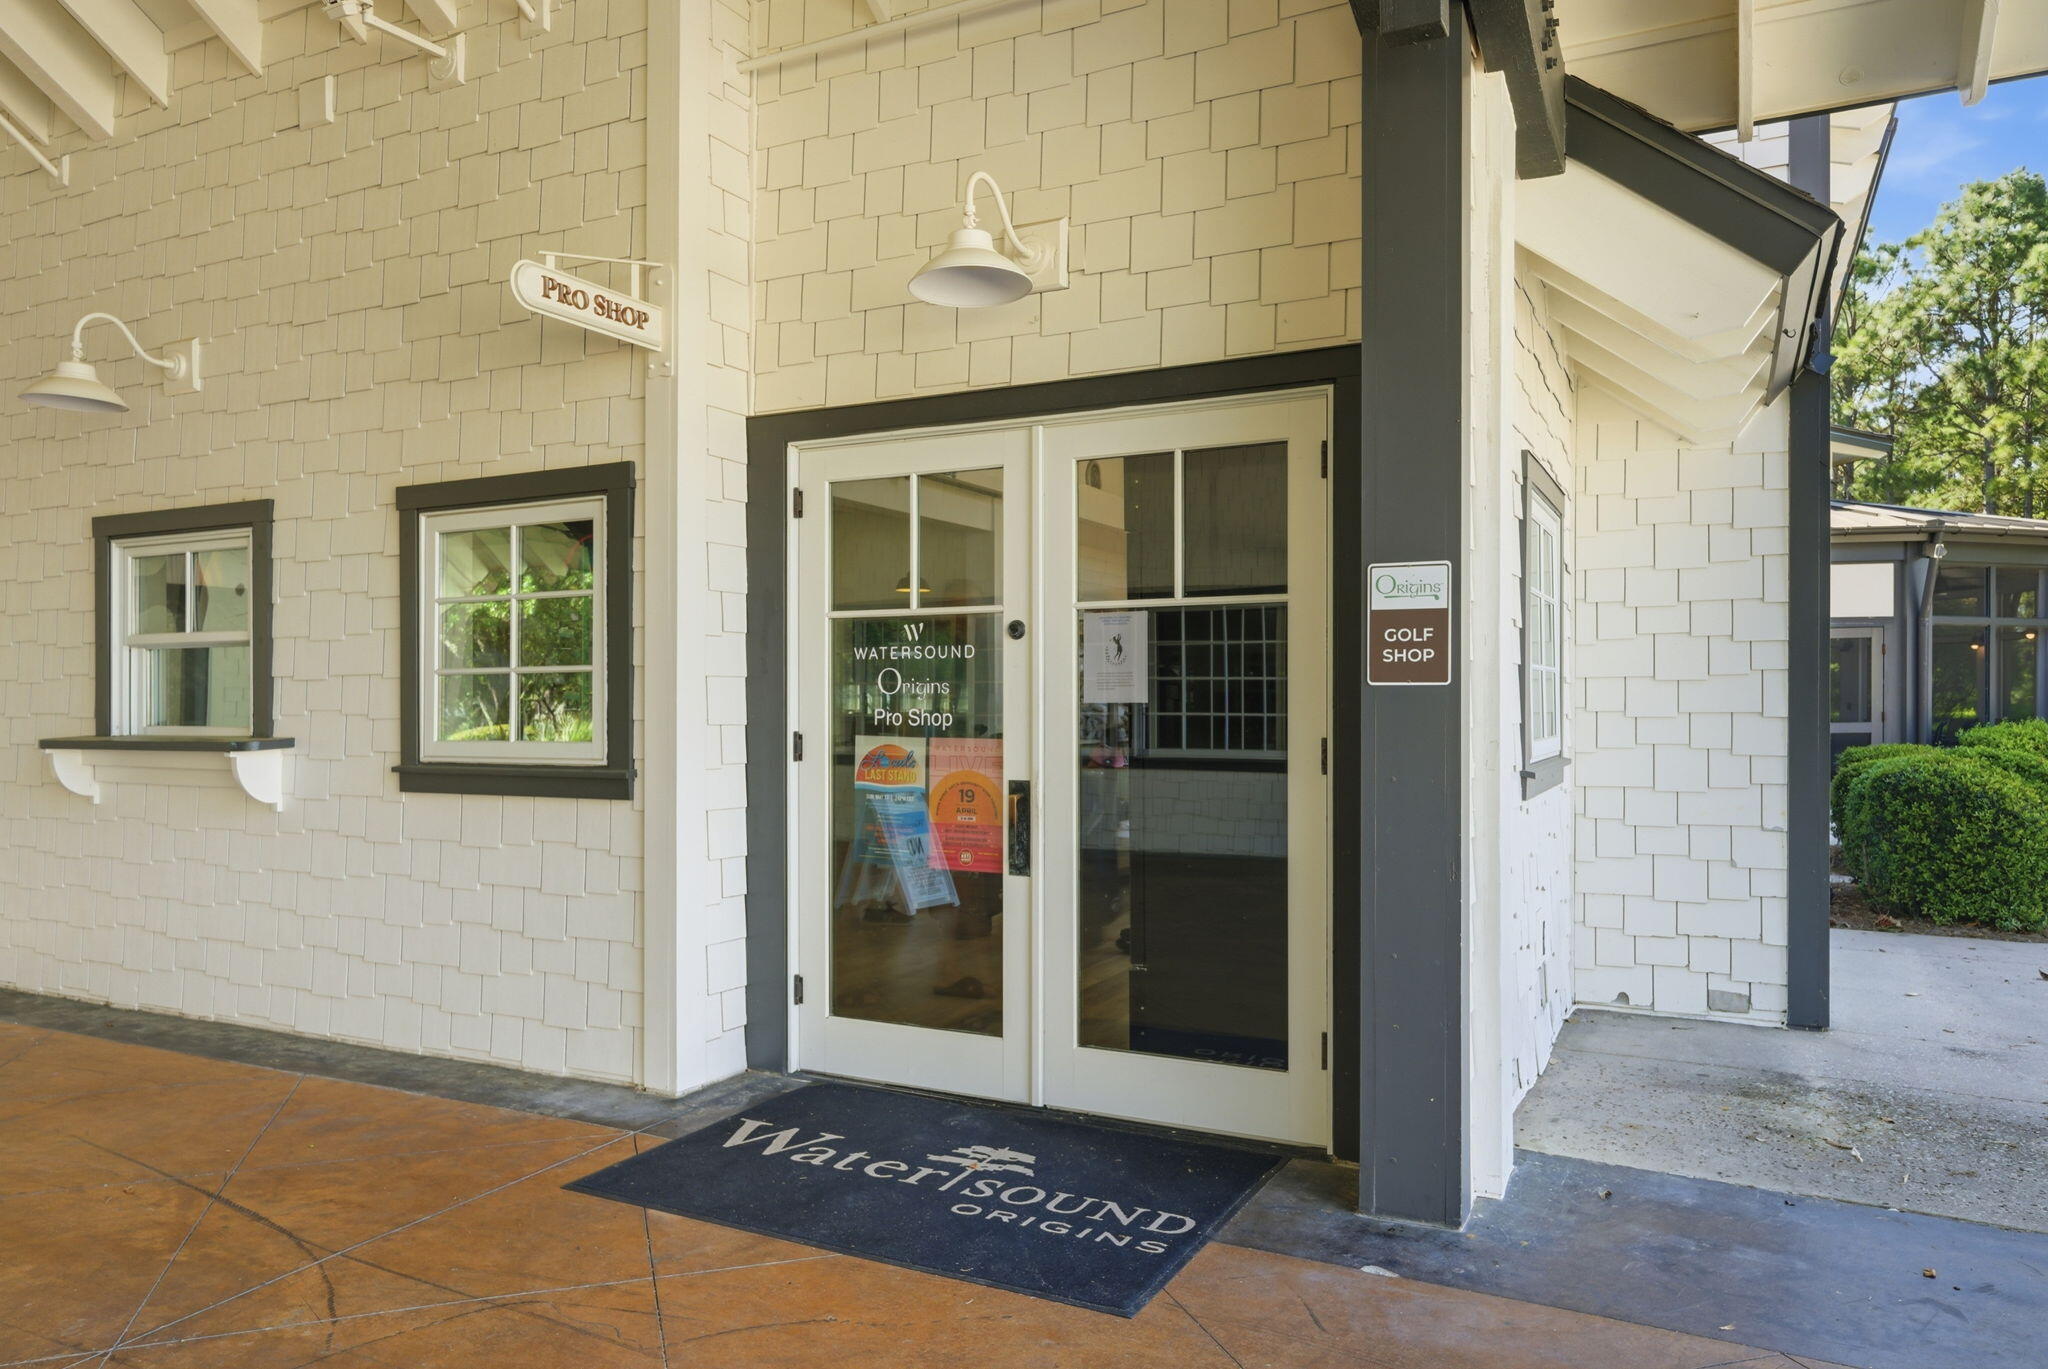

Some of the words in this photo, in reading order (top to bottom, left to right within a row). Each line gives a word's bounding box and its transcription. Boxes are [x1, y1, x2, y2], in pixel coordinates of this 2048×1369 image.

[541, 275, 590, 310] PRO
[593, 294, 650, 330] SHOP
[1384, 627, 1434, 642] GOLF
[854, 644, 975, 660] WATERSOUND
[1382, 648, 1435, 663] SHOP
[877, 667, 950, 700] Origins
[874, 708, 903, 726] Pro
[908, 708, 953, 731] Shop
[864, 768, 887, 781] LAST
[888, 769, 917, 783] STAND
[959, 788, 975, 804] 19
[956, 807, 978, 815] APRIL
[951, 1203, 1172, 1255] ORIGINS
